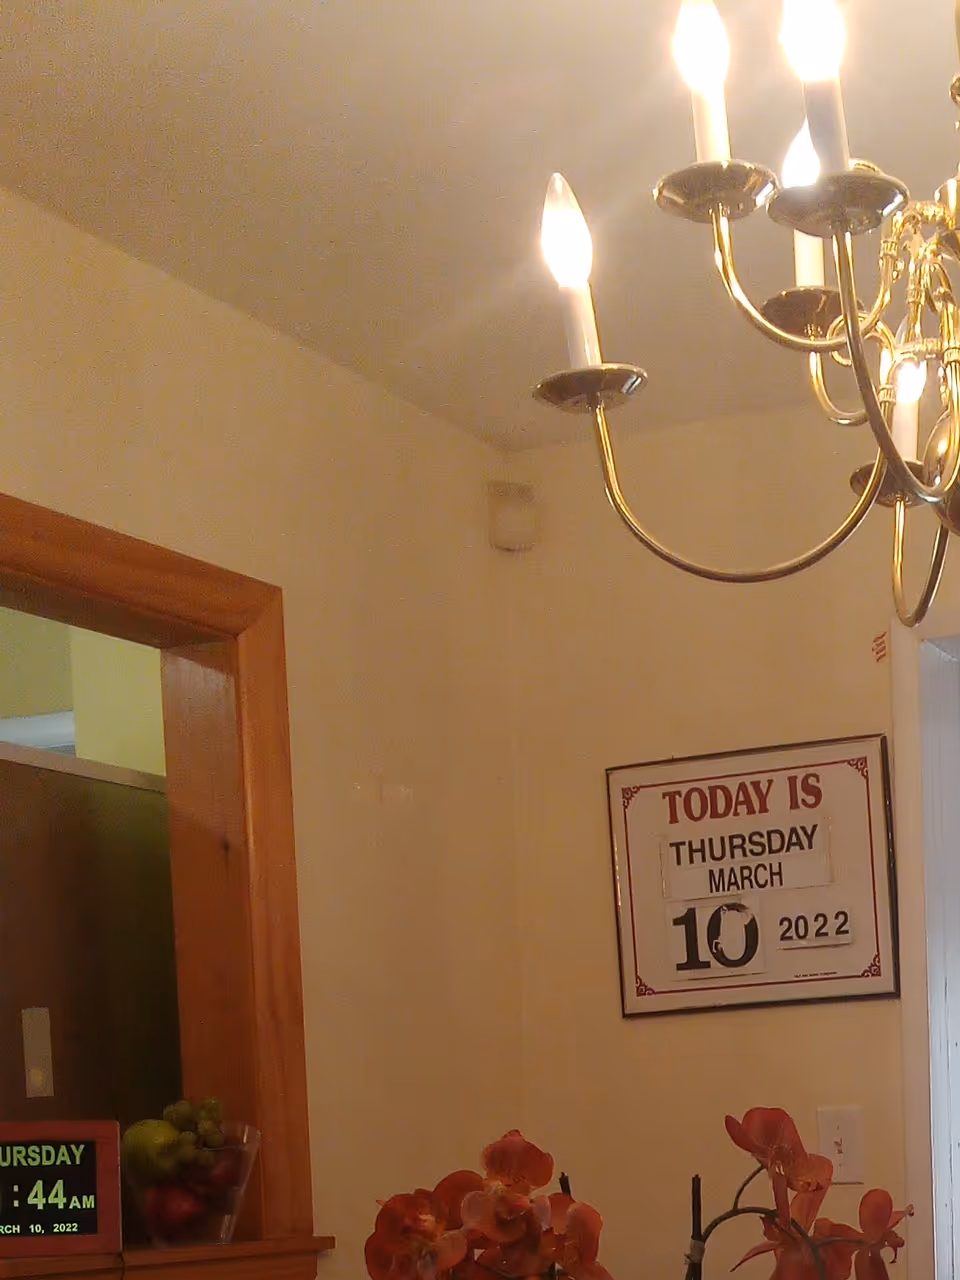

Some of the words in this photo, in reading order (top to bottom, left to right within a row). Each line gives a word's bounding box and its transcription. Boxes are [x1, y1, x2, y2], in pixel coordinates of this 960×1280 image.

[661, 778, 774, 824] TODAY
[787, 772, 823, 810] IS
[669, 824, 818, 866] THURSDAY
[708, 862, 783, 893] MARCH
[672, 902, 759, 971] 10
[778, 910, 850, 942] 2022
[0, 1144, 85, 1167] URSDAY
[68, 1195, 95, 1209] AM
[29, 1224, 45, 1234] 10,
[52, 1223, 78, 1233] 2022
